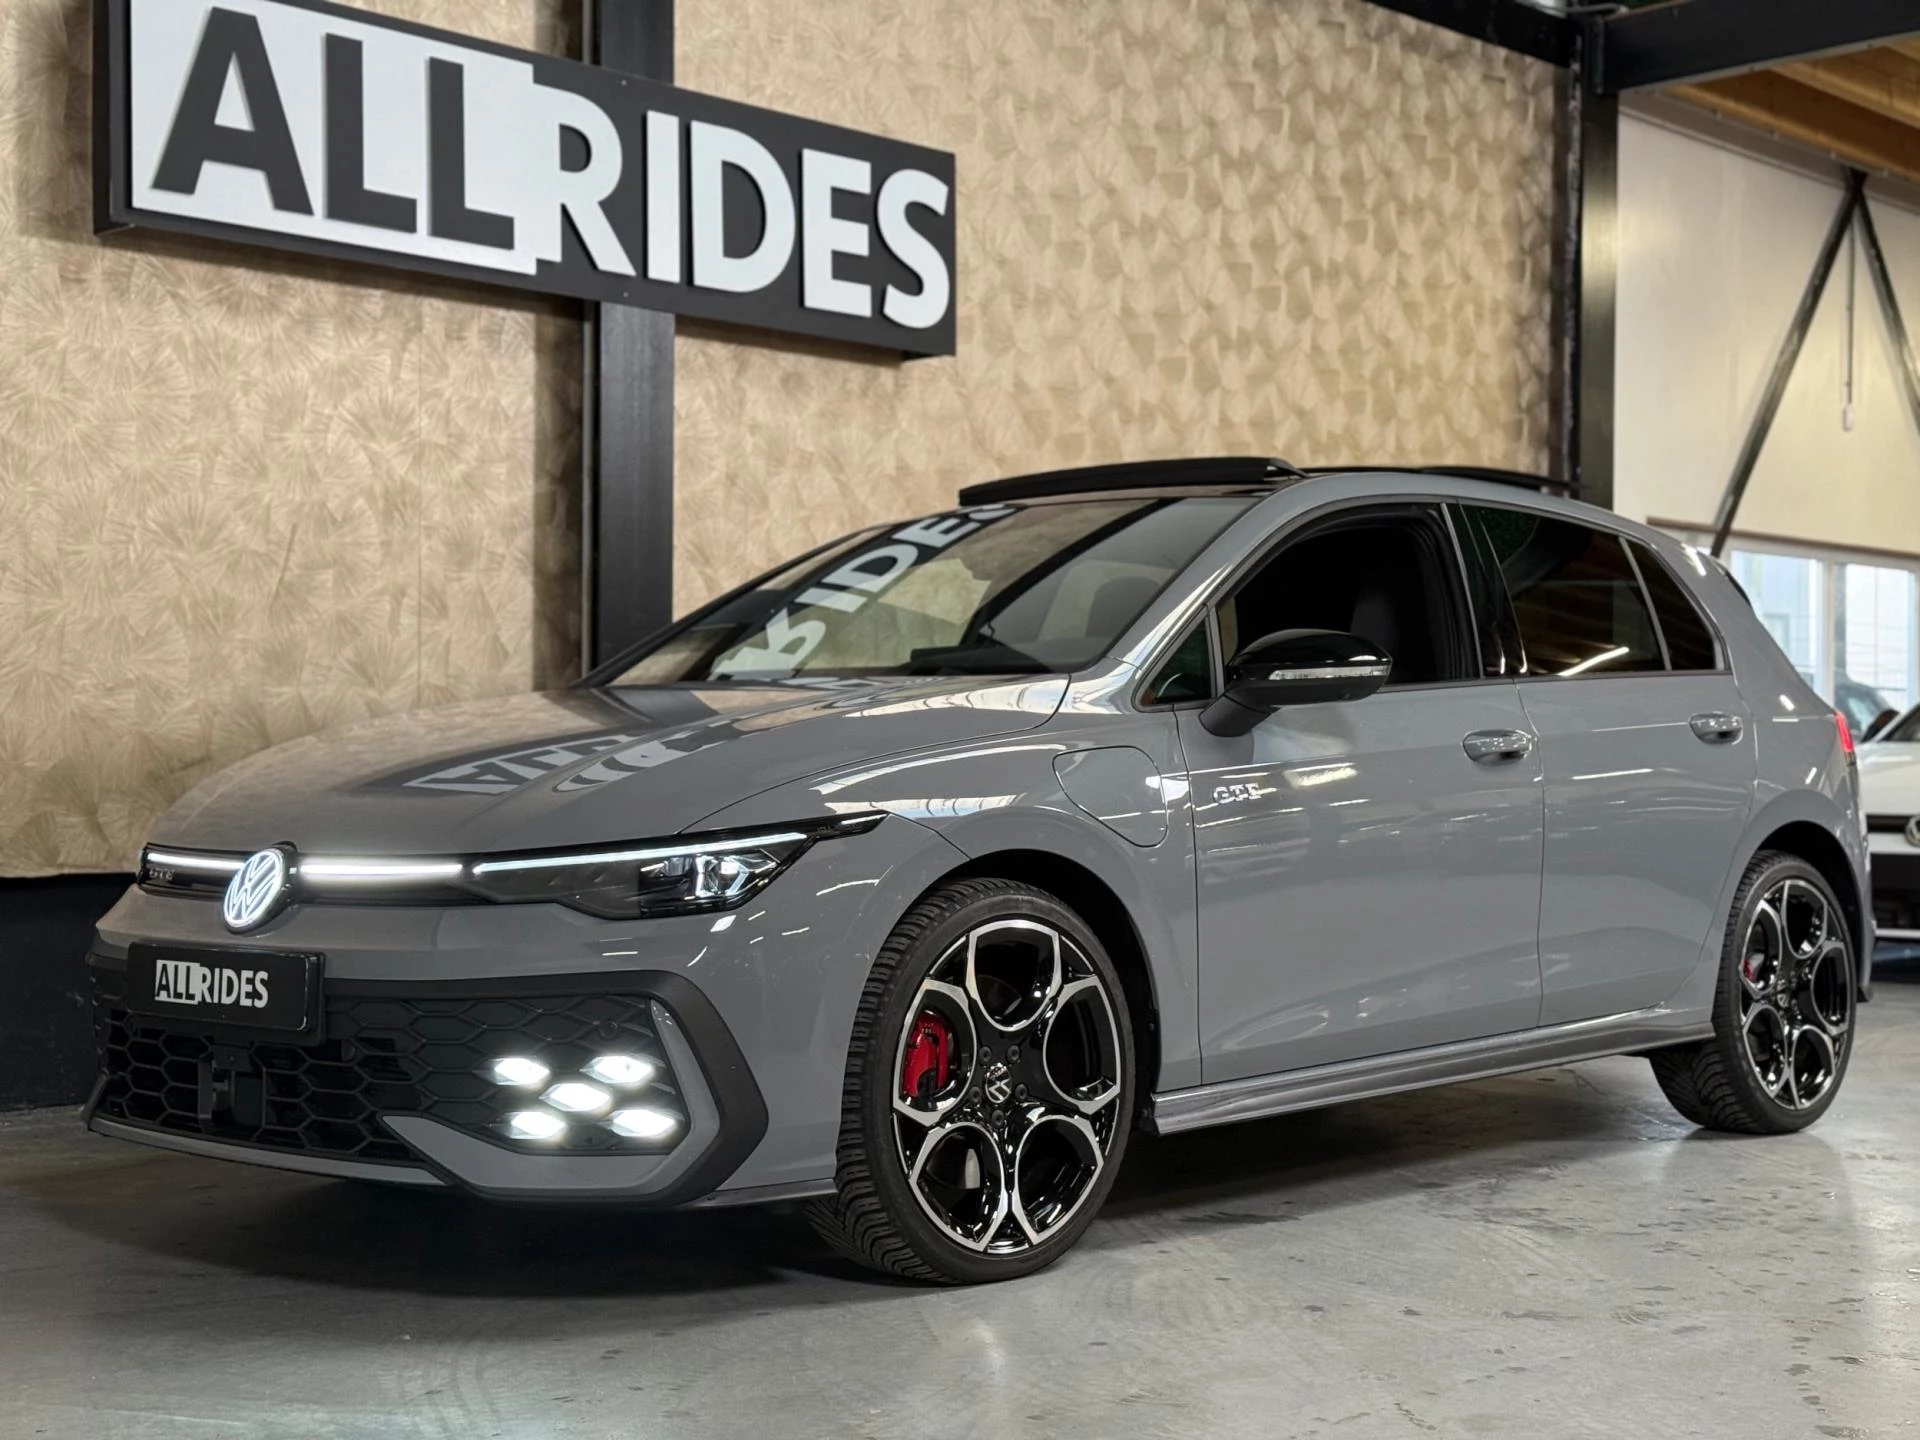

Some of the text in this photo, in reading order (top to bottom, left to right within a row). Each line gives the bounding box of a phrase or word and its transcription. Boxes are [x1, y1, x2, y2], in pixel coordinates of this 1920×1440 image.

[150, 5, 951, 330] ALLRIDES
[1213, 782, 1262, 804] GTE
[156, 962, 269, 1009] ALLRIDES
